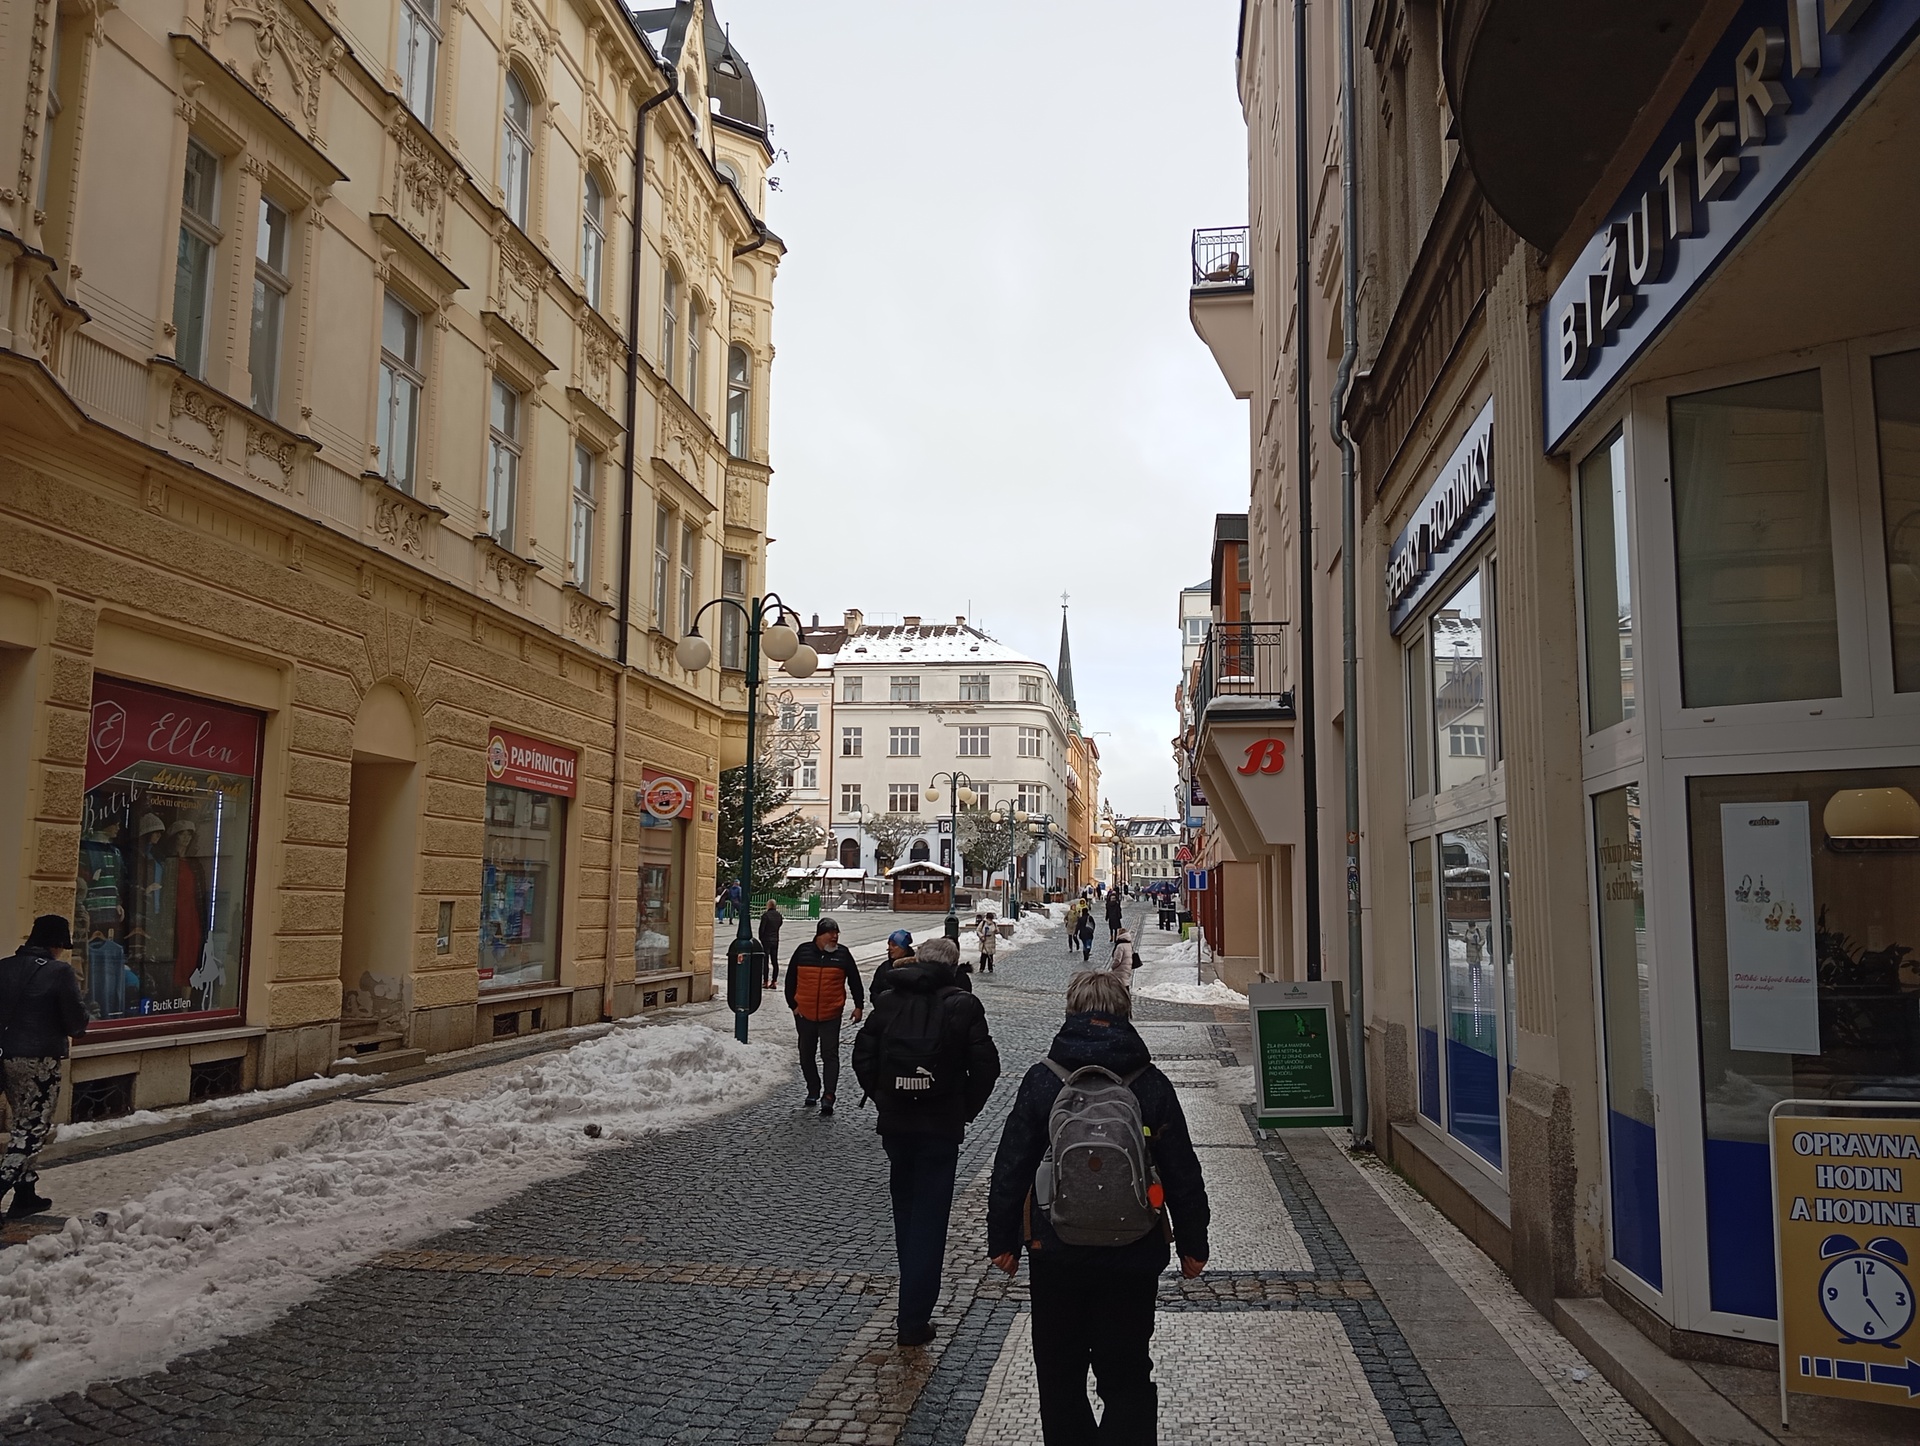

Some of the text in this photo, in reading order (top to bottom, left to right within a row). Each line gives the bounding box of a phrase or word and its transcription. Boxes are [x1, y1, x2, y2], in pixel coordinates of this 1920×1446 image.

[1560, 0, 1870, 381] BIŽUTERI
[1429, 423, 1494, 554] HODINKY
[147, 712, 243, 764] Ellen
[510, 745, 575, 779] PAPÍRNICTVÍ
[1237, 738, 1287, 776] B
[84, 770, 143, 832] Butik
[152, 999, 172, 1012] Butik
[173, 997, 191, 1010] Ellen
[895, 1076, 931, 1090] PUMA
[1793, 1131, 1920, 1159] OPRAVNA
[1816, 1164, 1902, 1193] HODIN
[1790, 1196, 1812, 1222] A
[1853, 1260, 1876, 1275] 12
[1827, 1287, 1906, 1306] 9 3
[1863, 1321, 1875, 1336] 6
